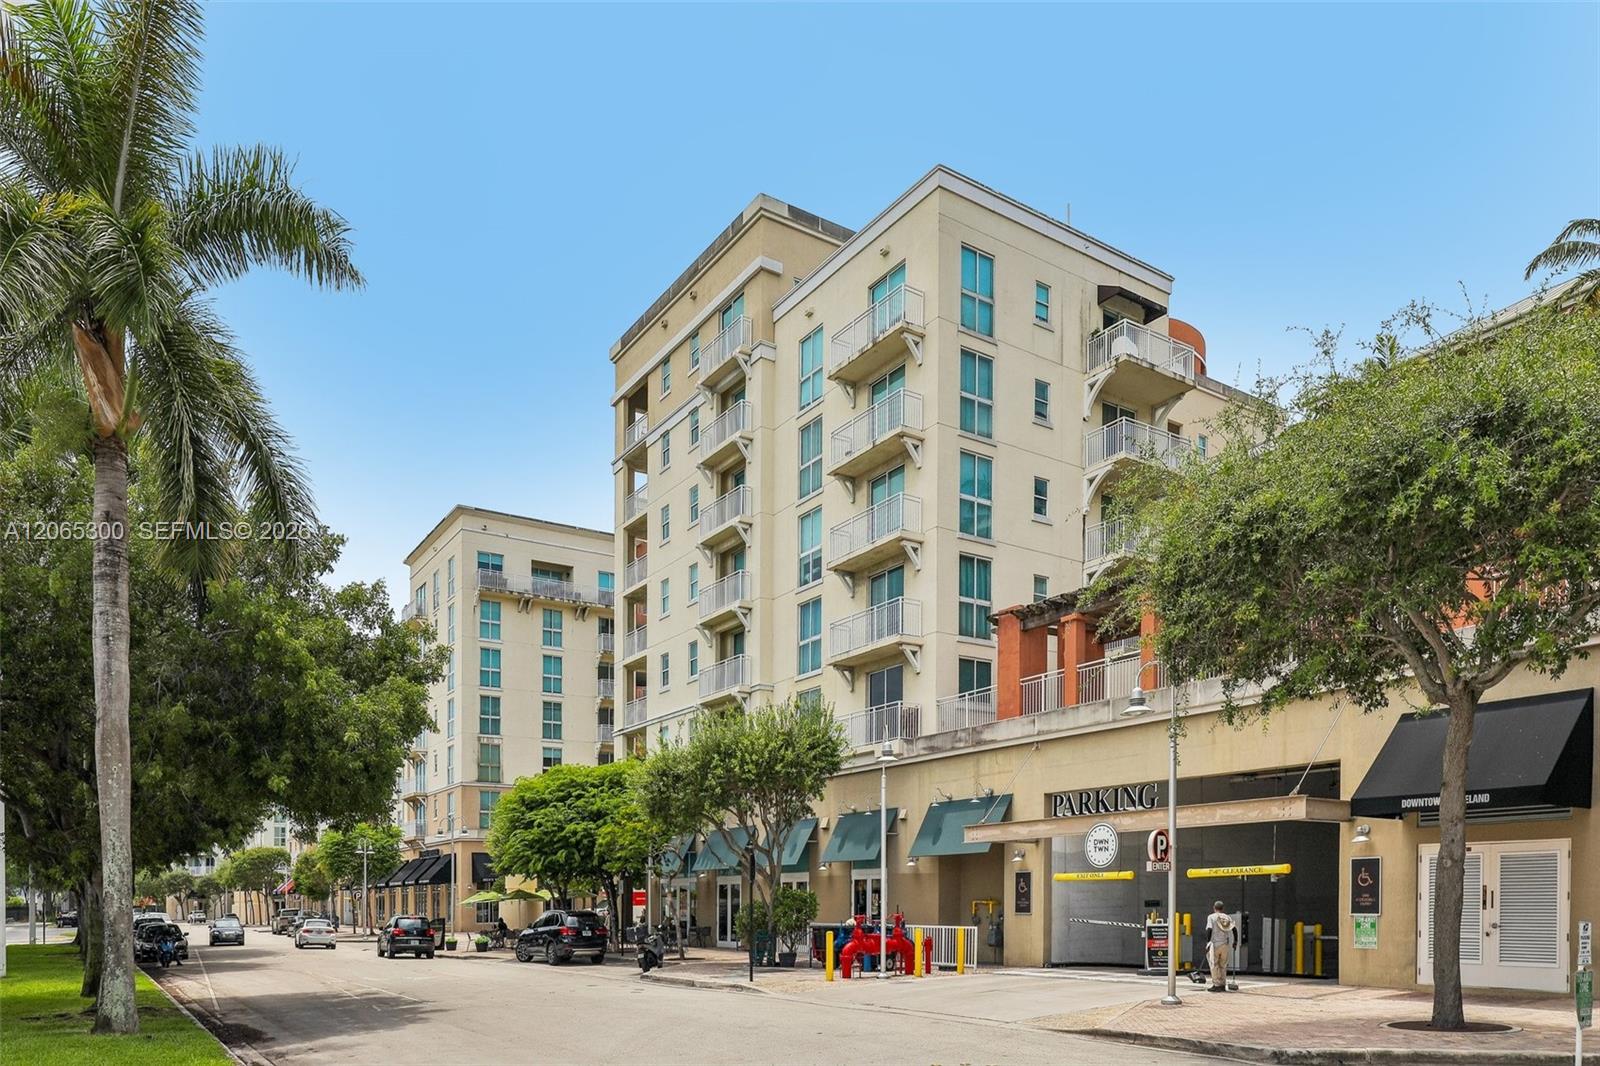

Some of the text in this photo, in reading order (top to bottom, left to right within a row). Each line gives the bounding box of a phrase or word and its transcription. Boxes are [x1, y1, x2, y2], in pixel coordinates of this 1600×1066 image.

[1052, 783, 1159, 818] PARKING
[1401, 793, 1490, 809] DOWNTOW ELAND
[1093, 838, 1109, 846] DWN
[1157, 835, 1167, 859] P
[1152, 862, 1170, 871] ENTER
